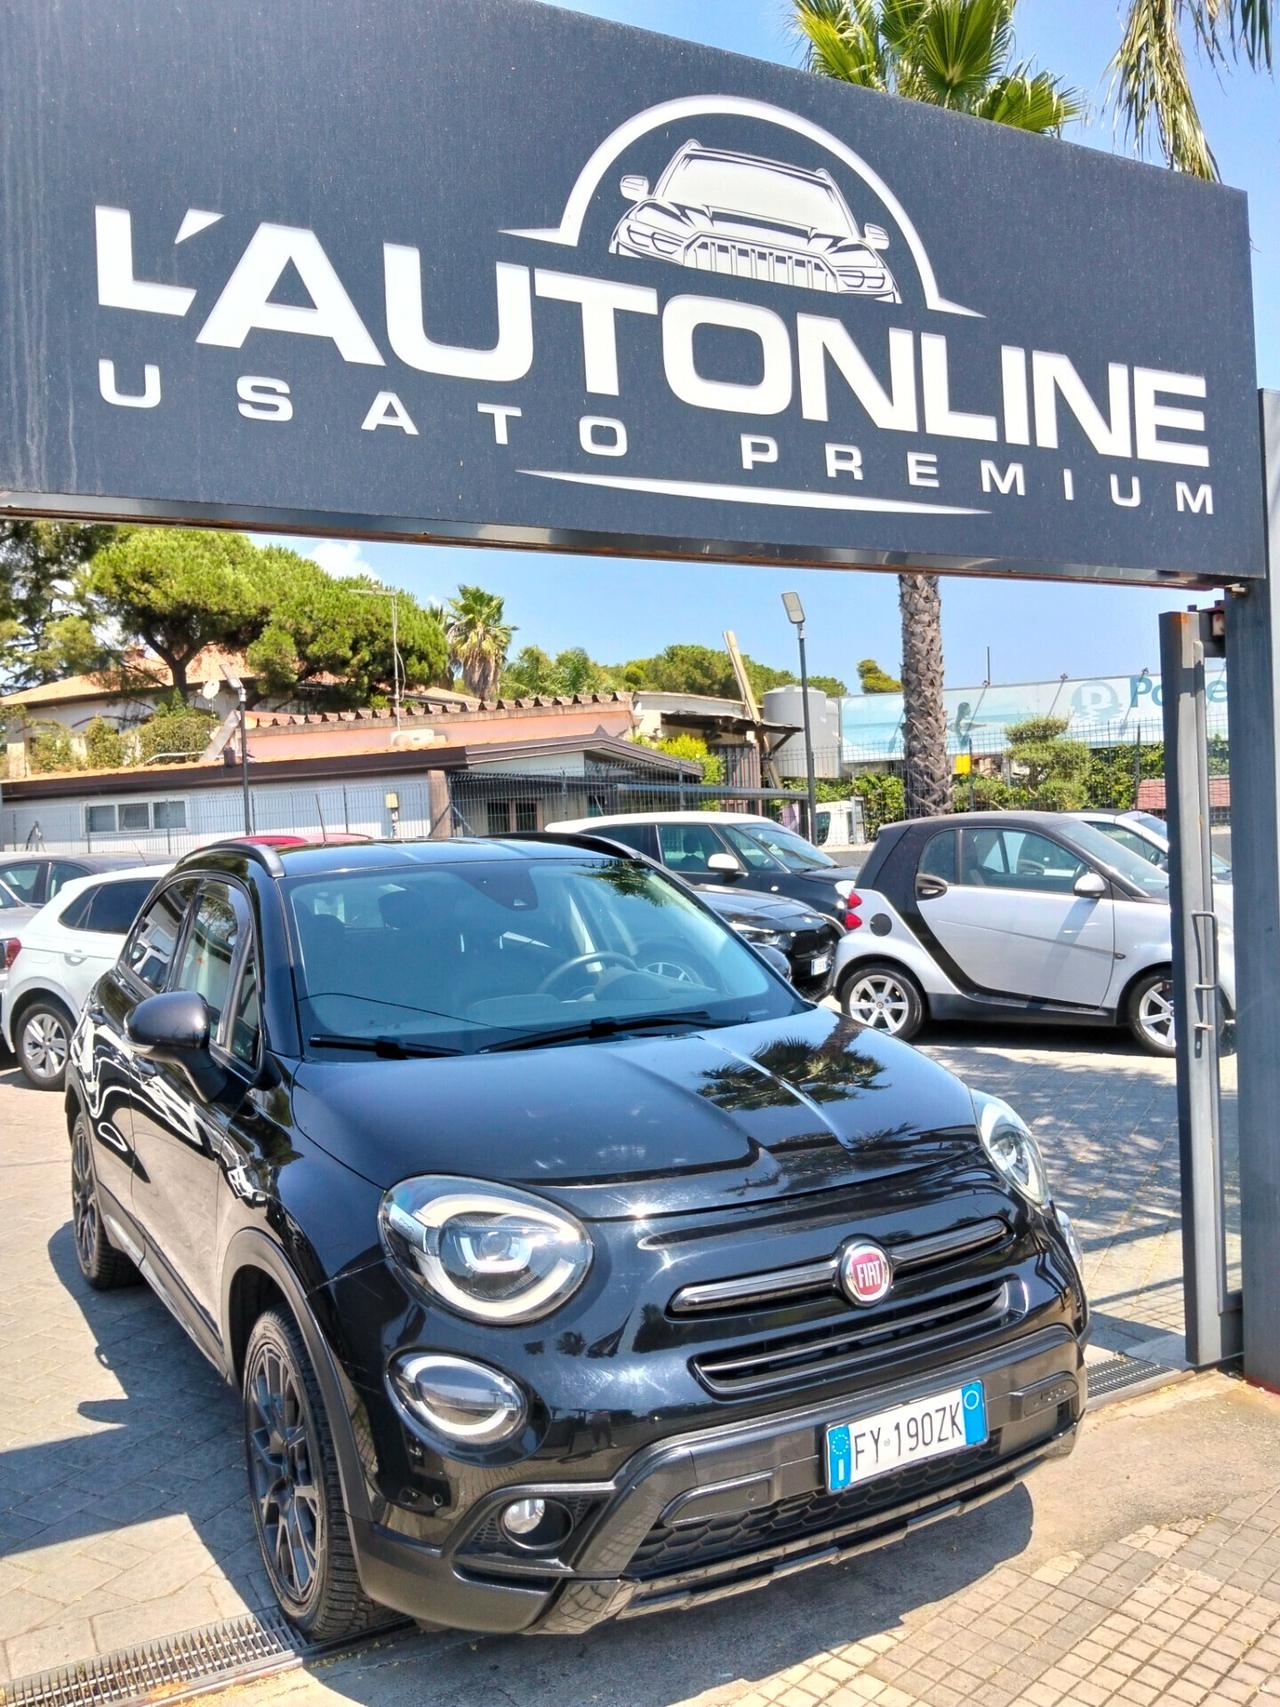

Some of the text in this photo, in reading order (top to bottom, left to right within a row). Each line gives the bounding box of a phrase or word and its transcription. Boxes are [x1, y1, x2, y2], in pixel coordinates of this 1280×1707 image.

[98, 359, 1214, 516] USATO PREMIUM
[856, 1260, 881, 1289] FIAT
[854, 1401, 963, 1471] FY 190ZK
